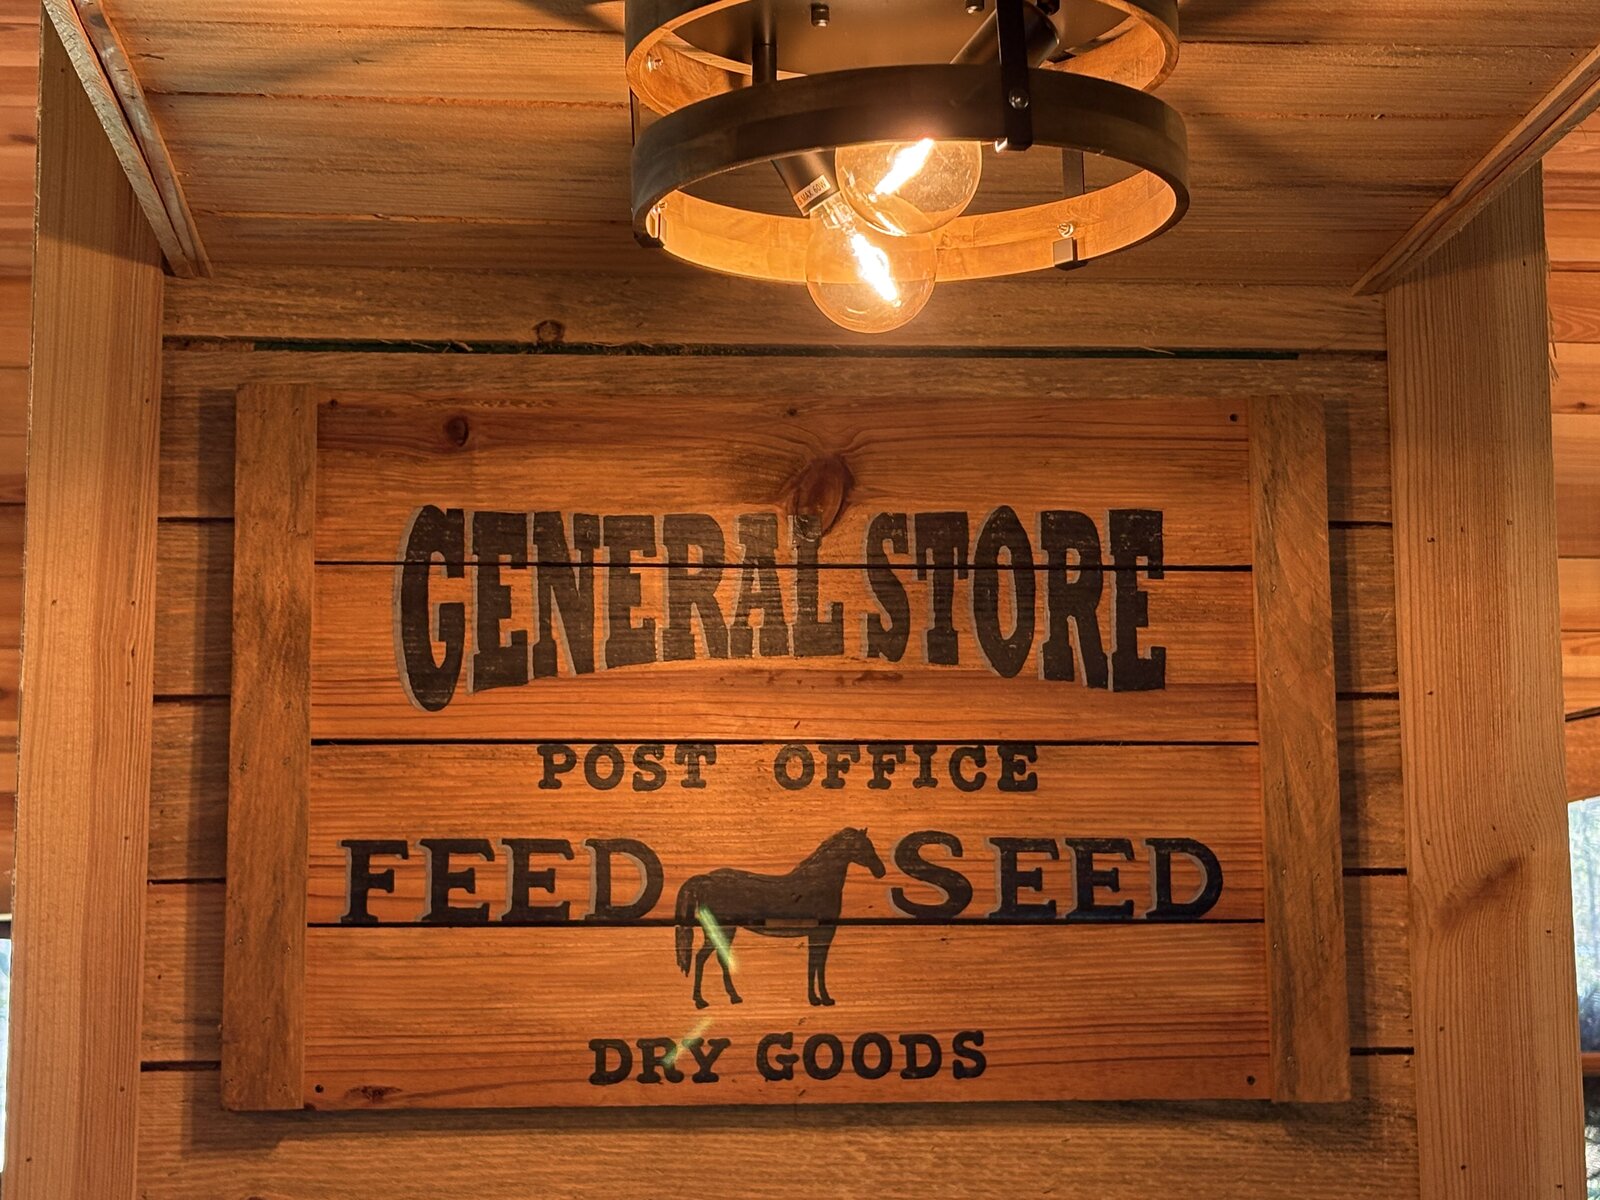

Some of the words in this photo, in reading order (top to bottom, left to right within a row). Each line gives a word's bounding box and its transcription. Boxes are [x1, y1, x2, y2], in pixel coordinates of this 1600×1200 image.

[812, 179, 827, 193] 60W
[393, 504, 844, 712] GENERAL
[862, 505, 1166, 692] STORE
[537, 743, 717, 791] POST
[774, 743, 1038, 792] OFFICE
[338, 838, 664, 923] FEED
[890, 830, 1223, 920] SEED
[588, 1037, 730, 1085] DRY
[757, 1031, 987, 1082] GOODS
